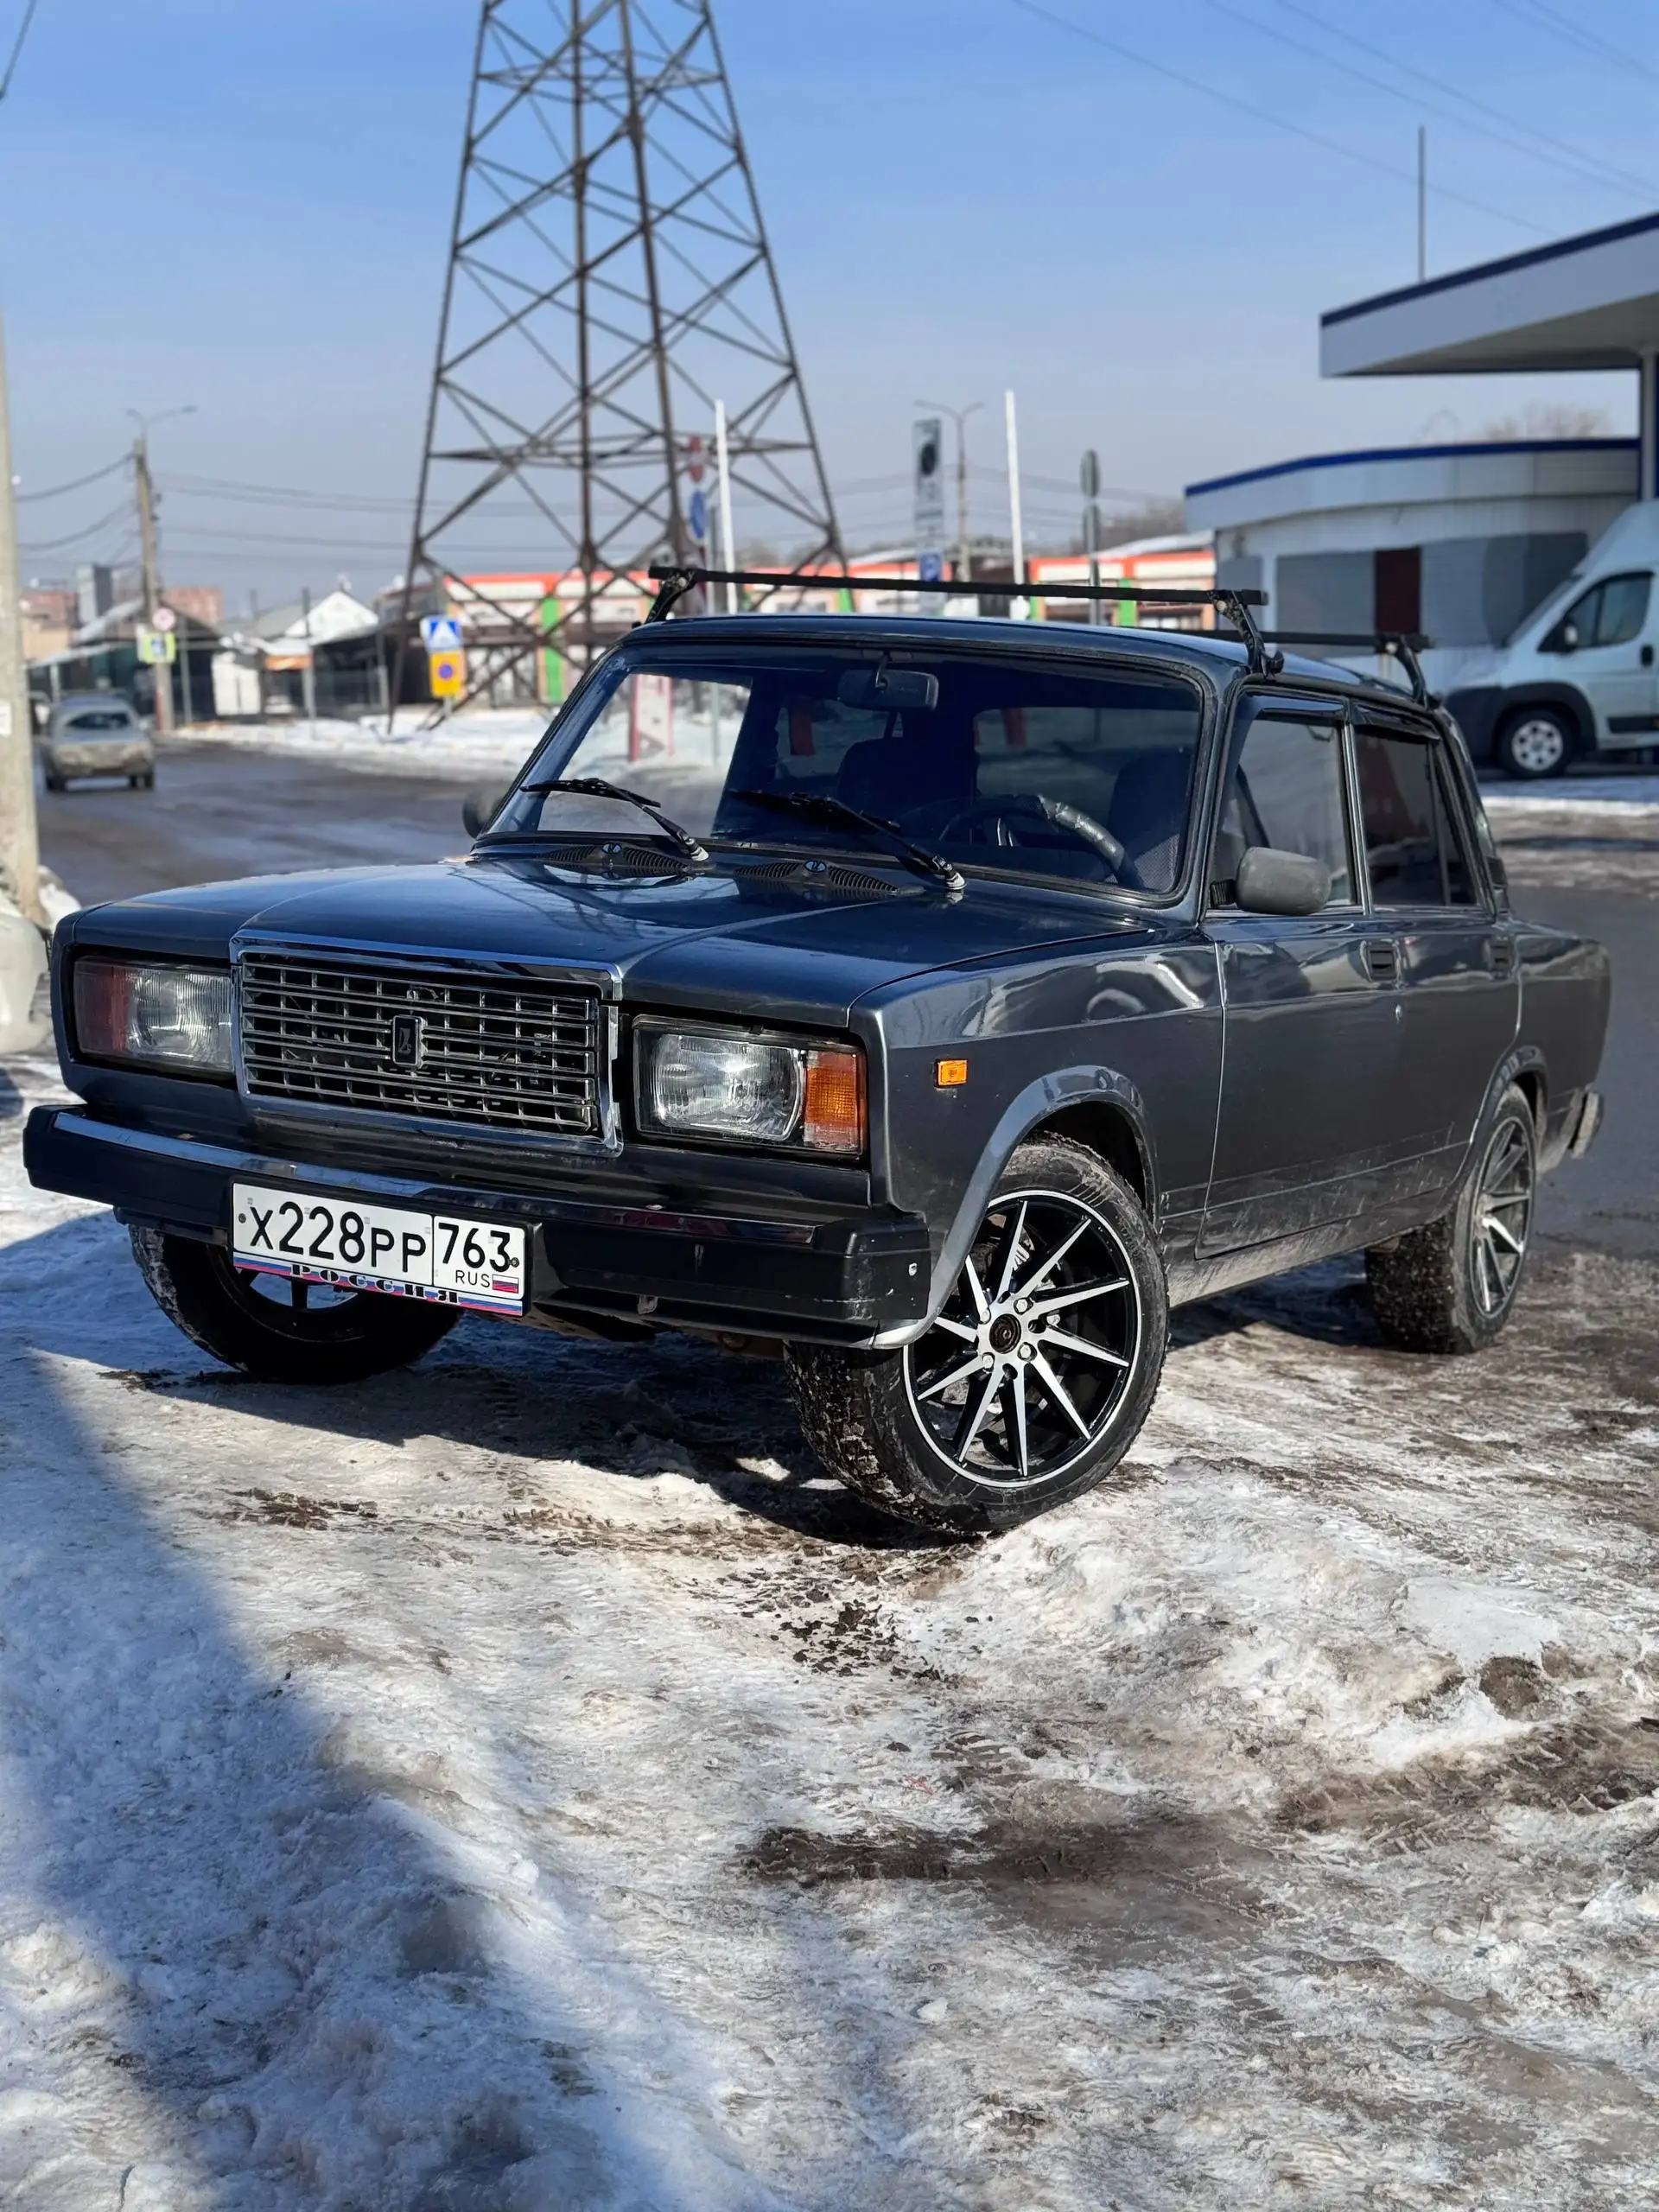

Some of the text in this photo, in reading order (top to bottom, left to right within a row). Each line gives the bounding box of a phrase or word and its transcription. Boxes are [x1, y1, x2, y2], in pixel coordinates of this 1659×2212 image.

[250, 1201, 512, 1273] Х228РР 763
[454, 1269, 490, 1288] RUS
